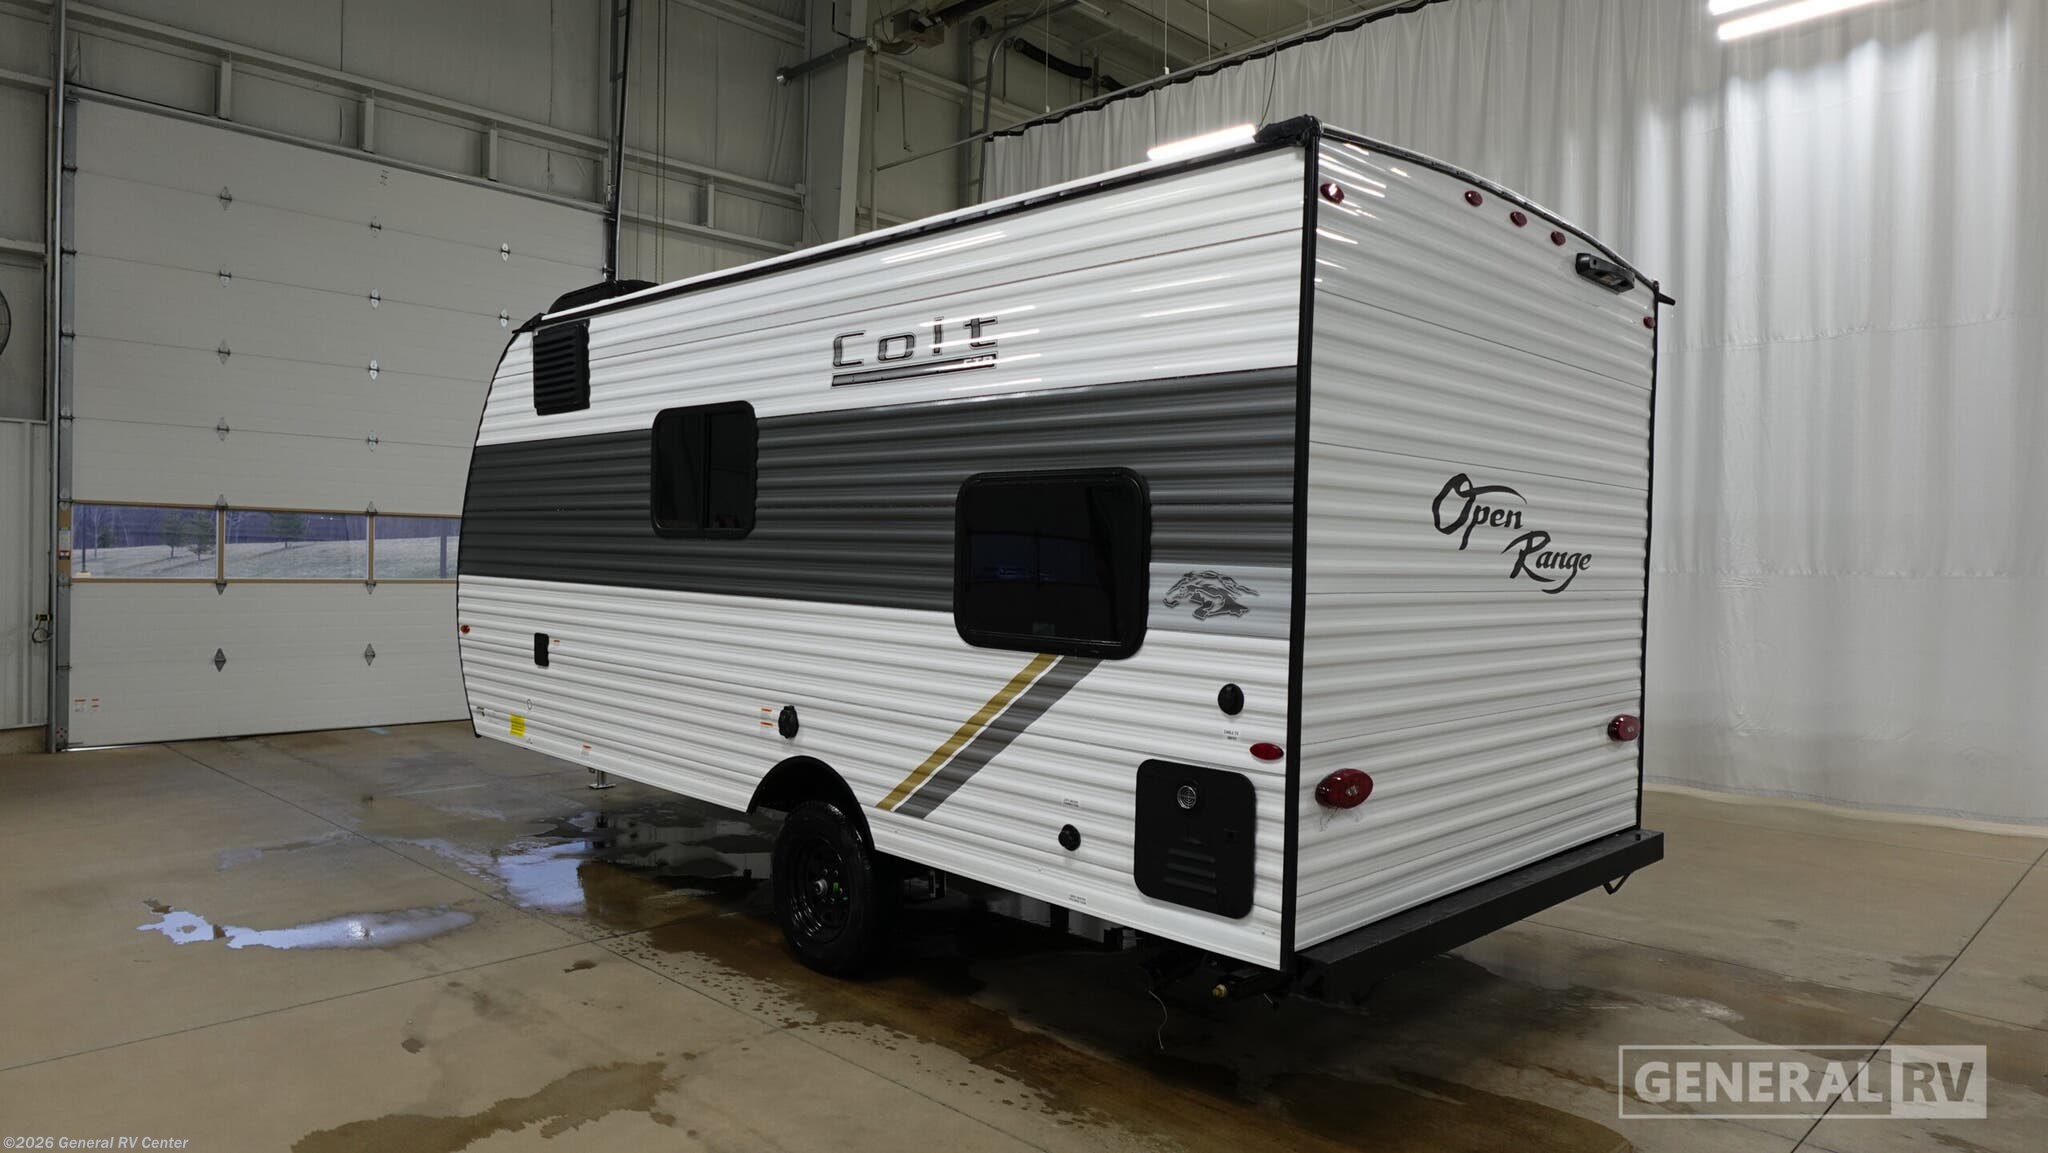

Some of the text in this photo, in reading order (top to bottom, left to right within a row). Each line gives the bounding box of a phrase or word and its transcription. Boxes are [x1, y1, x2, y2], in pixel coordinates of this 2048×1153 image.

[833, 316, 998, 369] Colt
[1432, 473, 1527, 550] Open
[1501, 531, 1592, 594] Range
